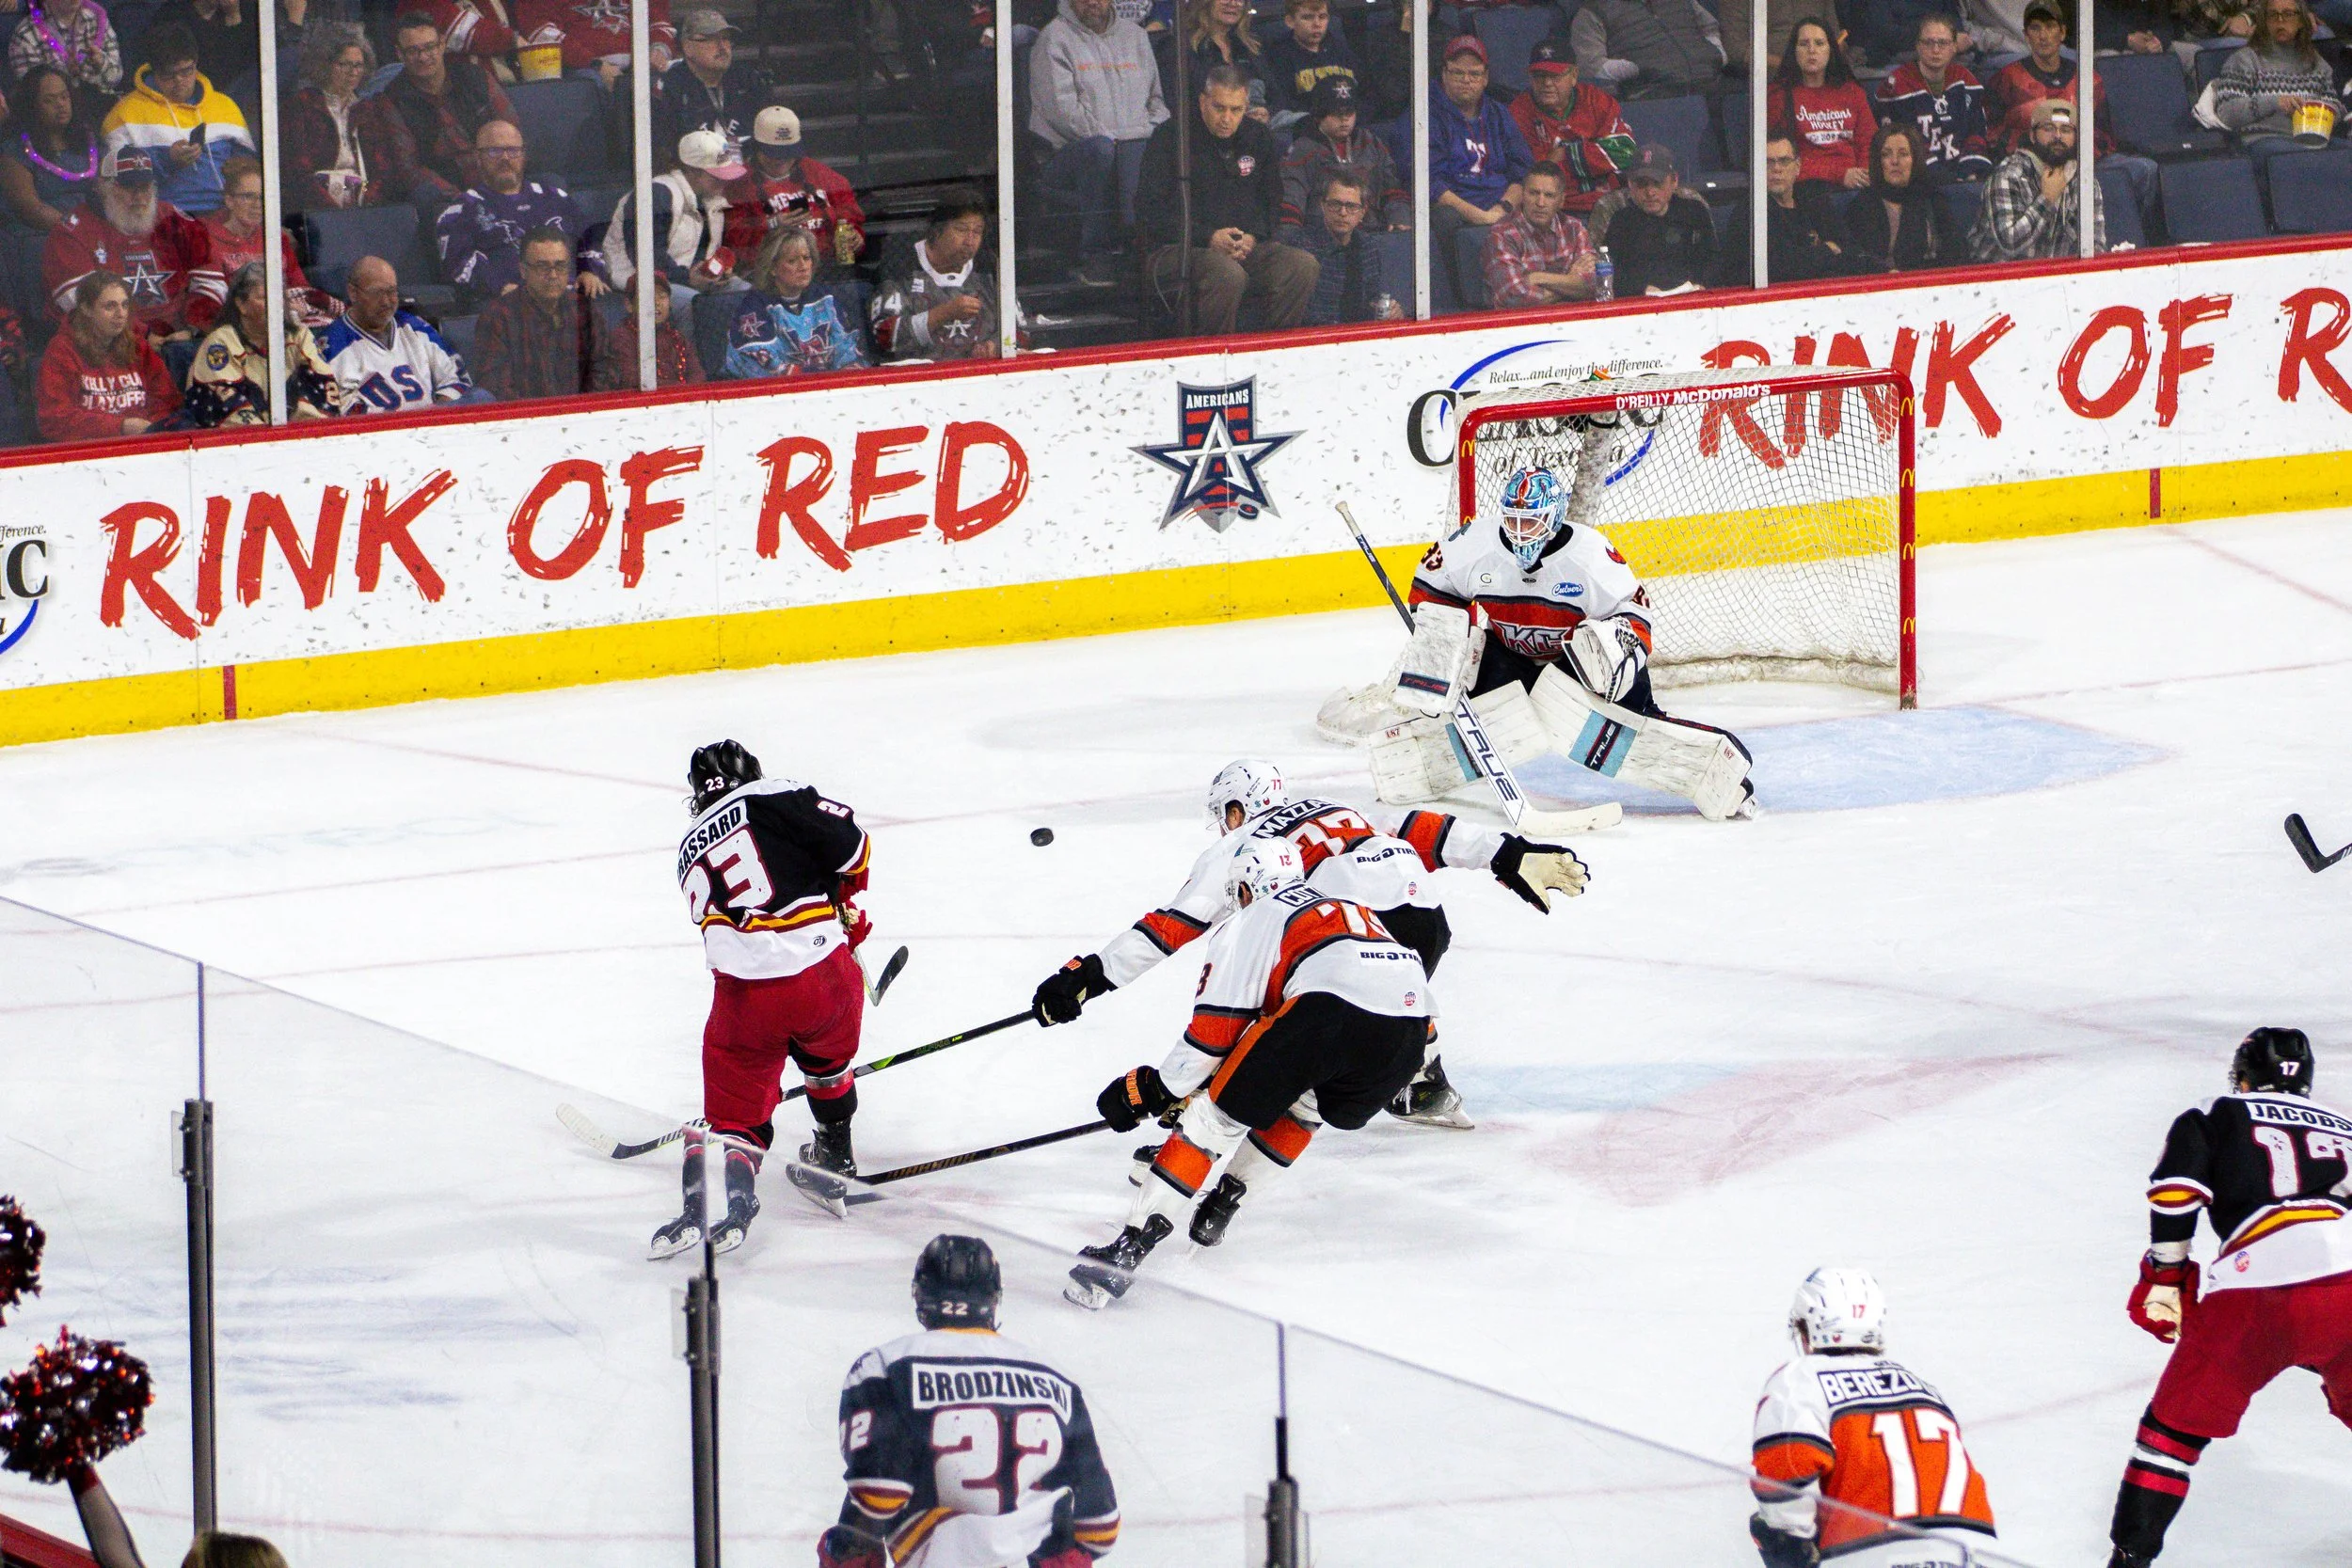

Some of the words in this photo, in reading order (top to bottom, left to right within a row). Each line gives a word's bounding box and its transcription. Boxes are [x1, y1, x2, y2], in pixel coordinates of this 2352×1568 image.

[1555, 368, 1585, 379] enjoy
[1698, 313, 2015, 470] RINK
[2058, 293, 2233, 429] OF
[1185, 388, 1249, 409] AMERICANS
[1615, 392, 1670, 410] O'REILLY
[1672, 384, 1771, 405] McDonald's
[99, 467, 458, 641] RINK
[506, 444, 706, 589] OF
[755, 420, 1030, 573] RED
[1553, 583, 1584, 596] Culver's
[1457, 699, 1519, 802] TRUE
[1590, 722, 1616, 768] TRUE
[706, 776, 725, 792] 23
[677, 806, 741, 882] RASSARD
[1357, 852, 1381, 864] BIG
[680, 824, 776, 926] 23
[1360, 951, 1385, 959] BIG
[2279, 1060, 2301, 1077] 17
[940, 1301, 969, 1317] 22
[1851, 1304, 1867, 1319] 17
[918, 1371, 1068, 1413] BRODZINSKI
[930, 1403, 1064, 1516] 22
[1869, 1406, 1964, 1522] 17
